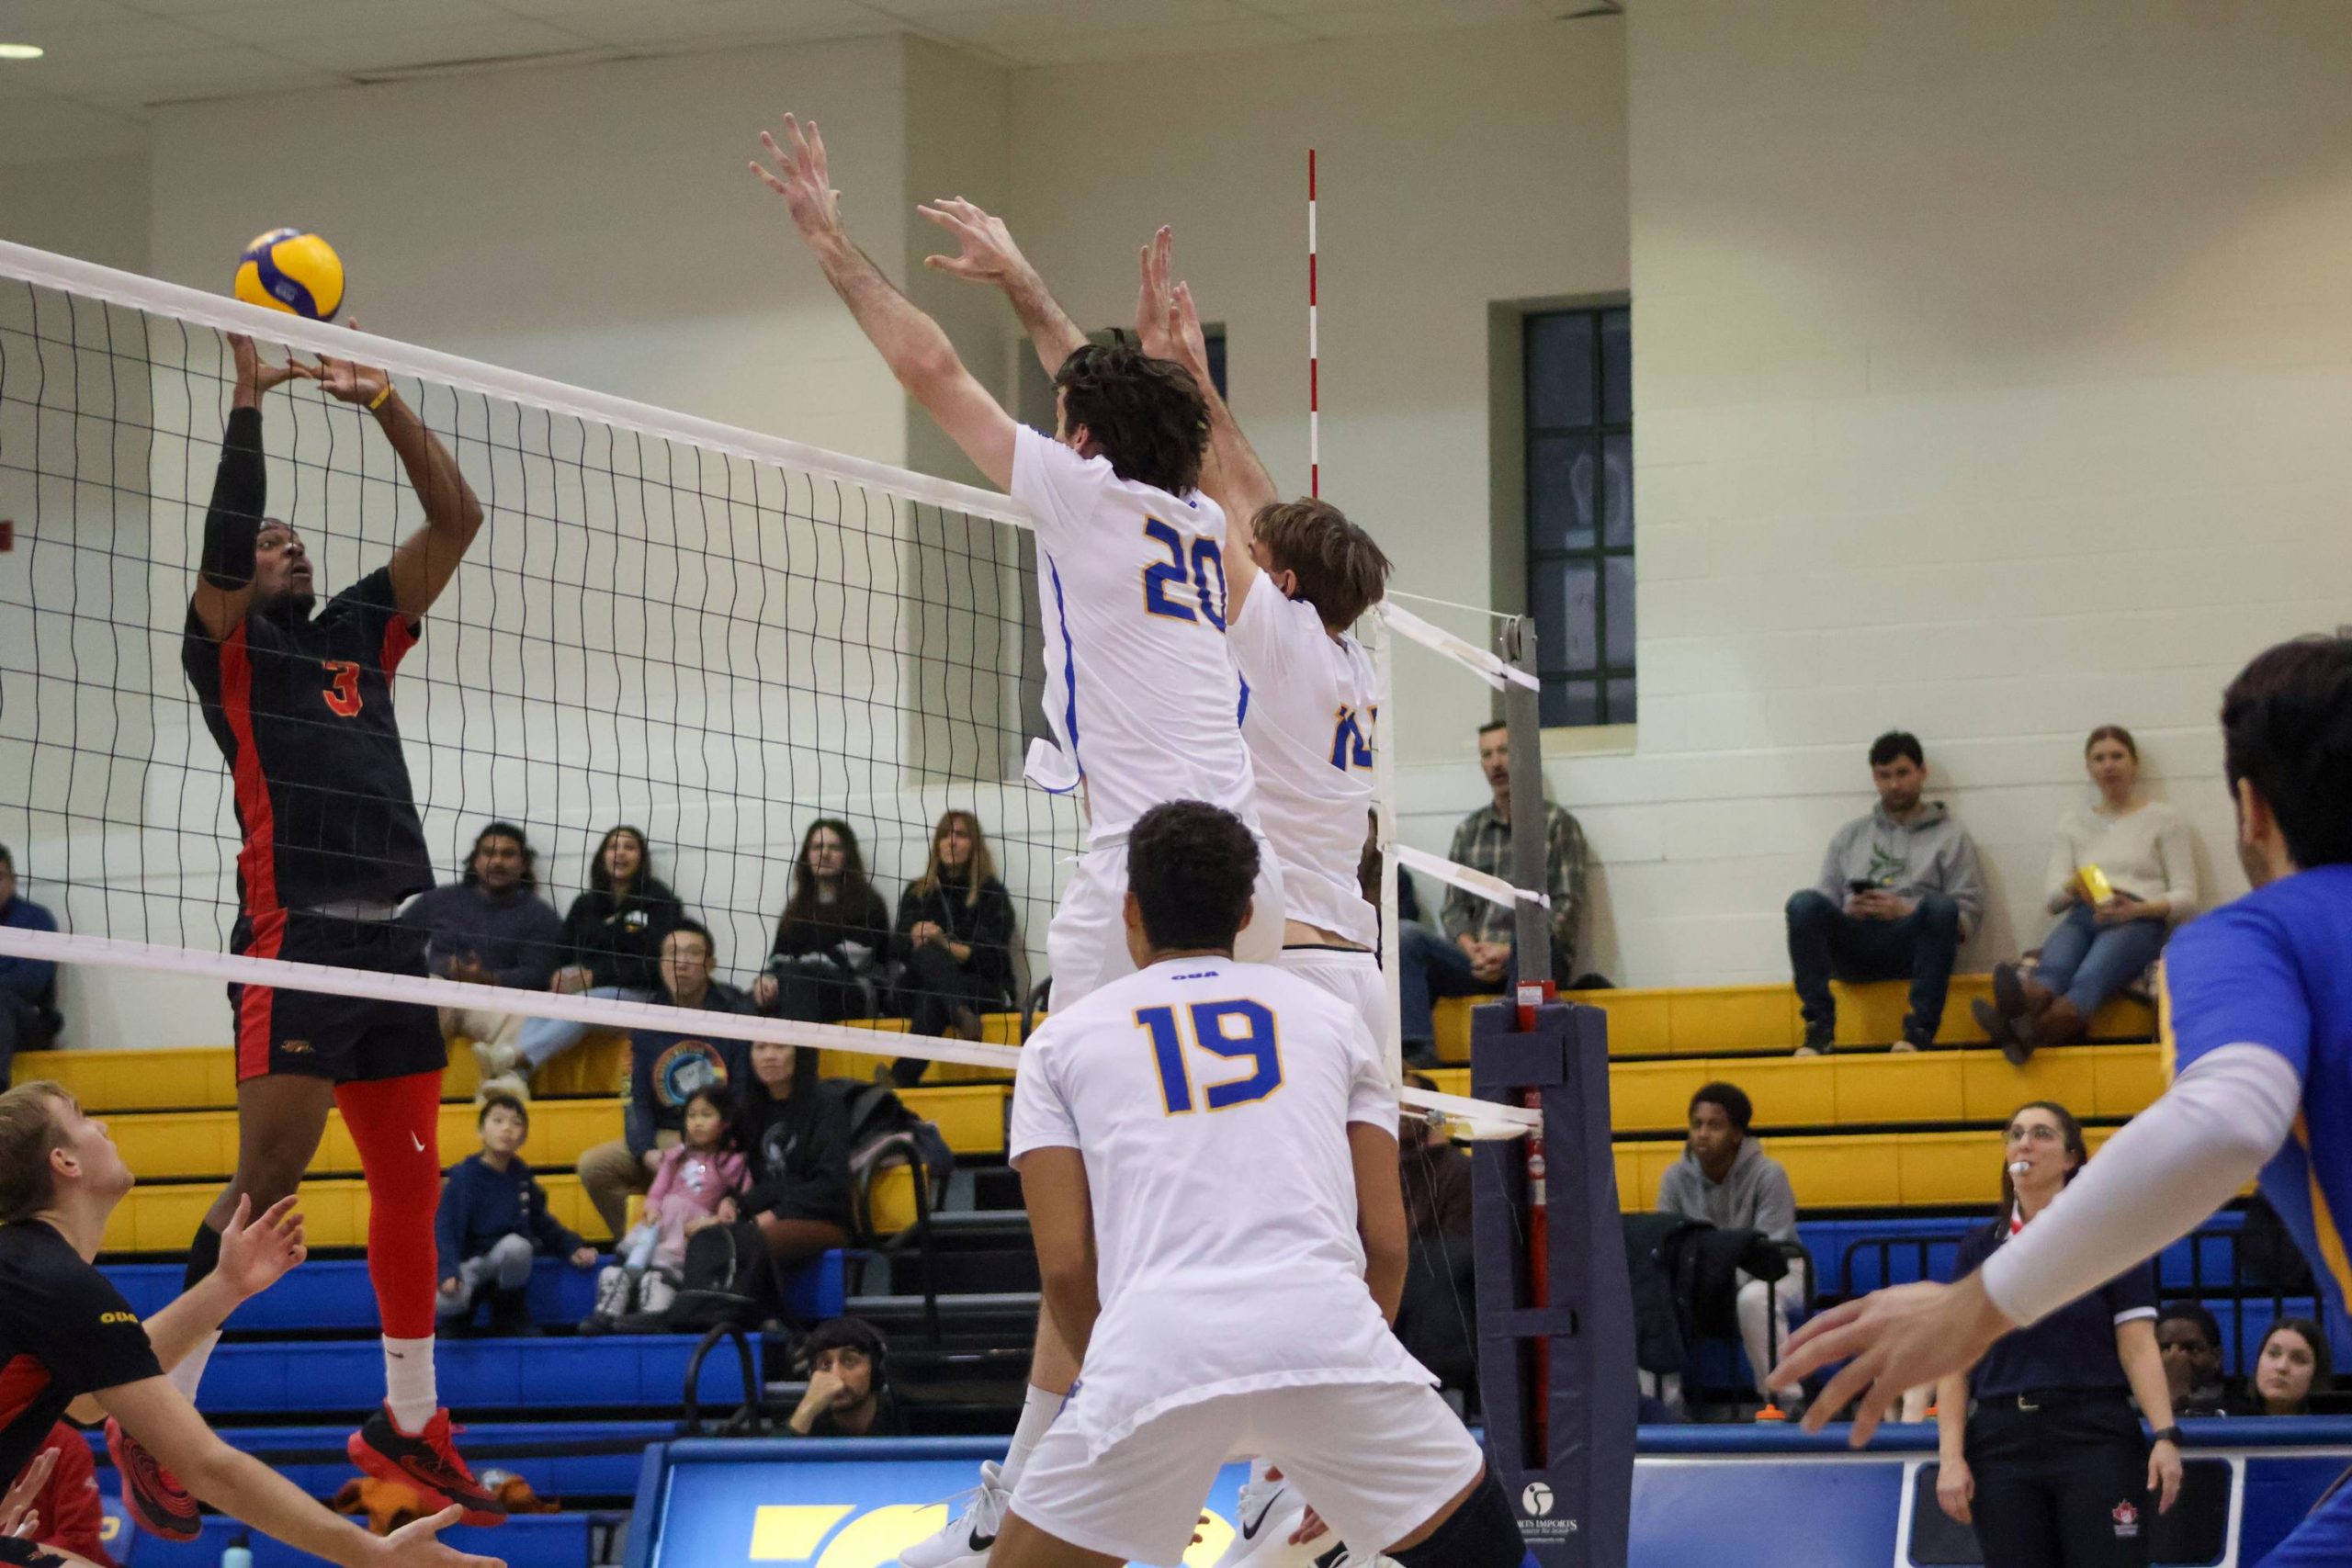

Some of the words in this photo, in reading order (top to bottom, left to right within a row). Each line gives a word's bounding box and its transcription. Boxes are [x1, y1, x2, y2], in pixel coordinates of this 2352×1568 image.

[1141, 514, 1226, 634] 20
[322, 660, 363, 717] 3
[1171, 971, 1219, 980] OUA
[1132, 997, 1285, 1117] 19
[1535, 1519, 1577, 1531] IMPORTS
